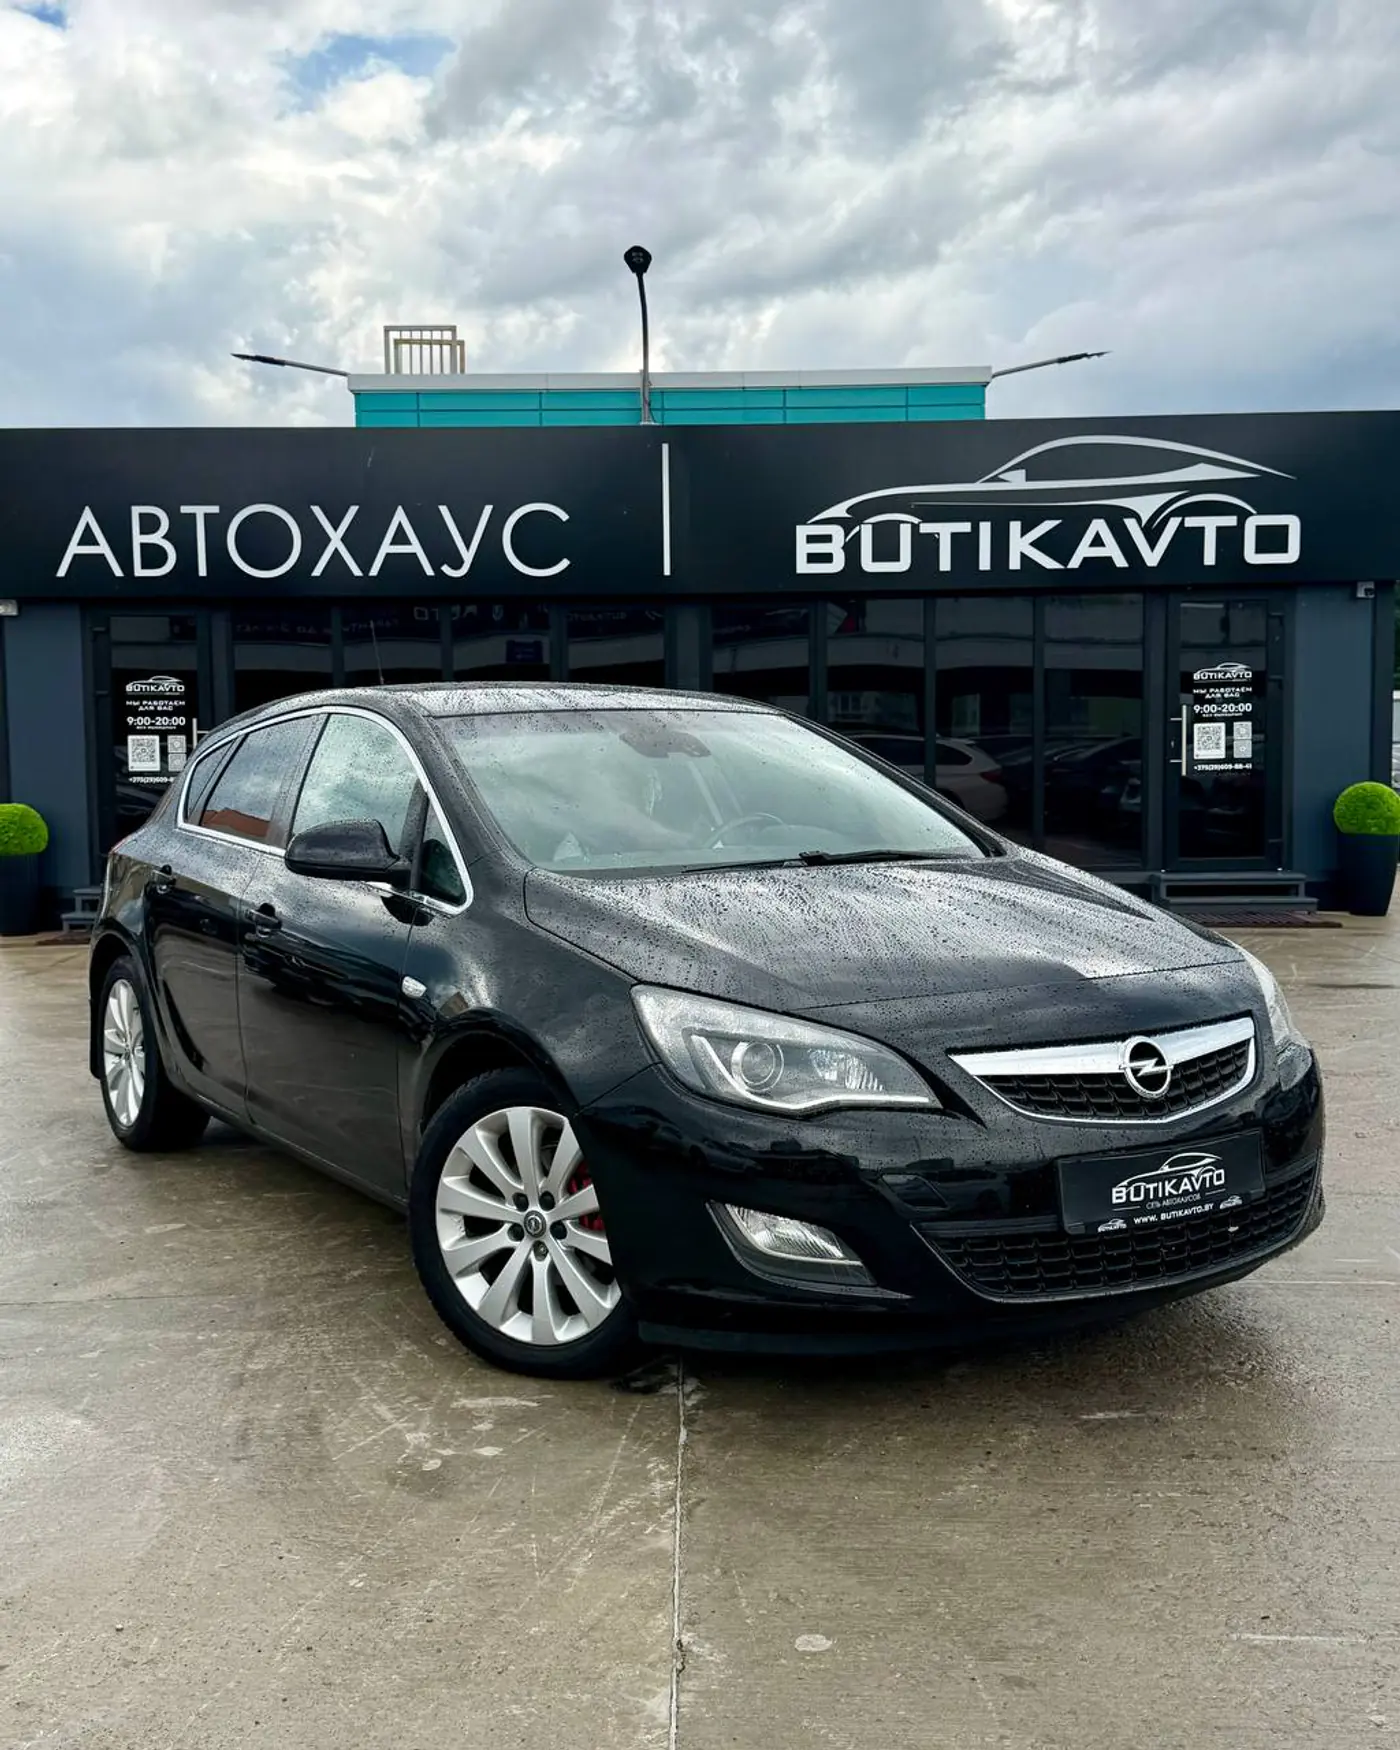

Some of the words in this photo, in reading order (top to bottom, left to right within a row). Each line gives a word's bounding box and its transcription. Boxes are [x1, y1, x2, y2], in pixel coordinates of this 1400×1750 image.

[56, 502, 571, 579] АВТОХАУС
[795, 513, 1301, 575] BUTIKAVTO
[1193, 671, 1252, 680] BUTIKAVTO
[125, 684, 185, 692] BUTIKAVTO
[1193, 703, 1253, 713] 9:00-20:00
[127, 716, 186, 726] 9:00-20:00
[1111, 1169, 1226, 1204] BUTIKAVTO
[1133, 1214, 1158, 1224] WWW.
[1160, 1203, 1214, 1221] BUTIKAVTO.BY
